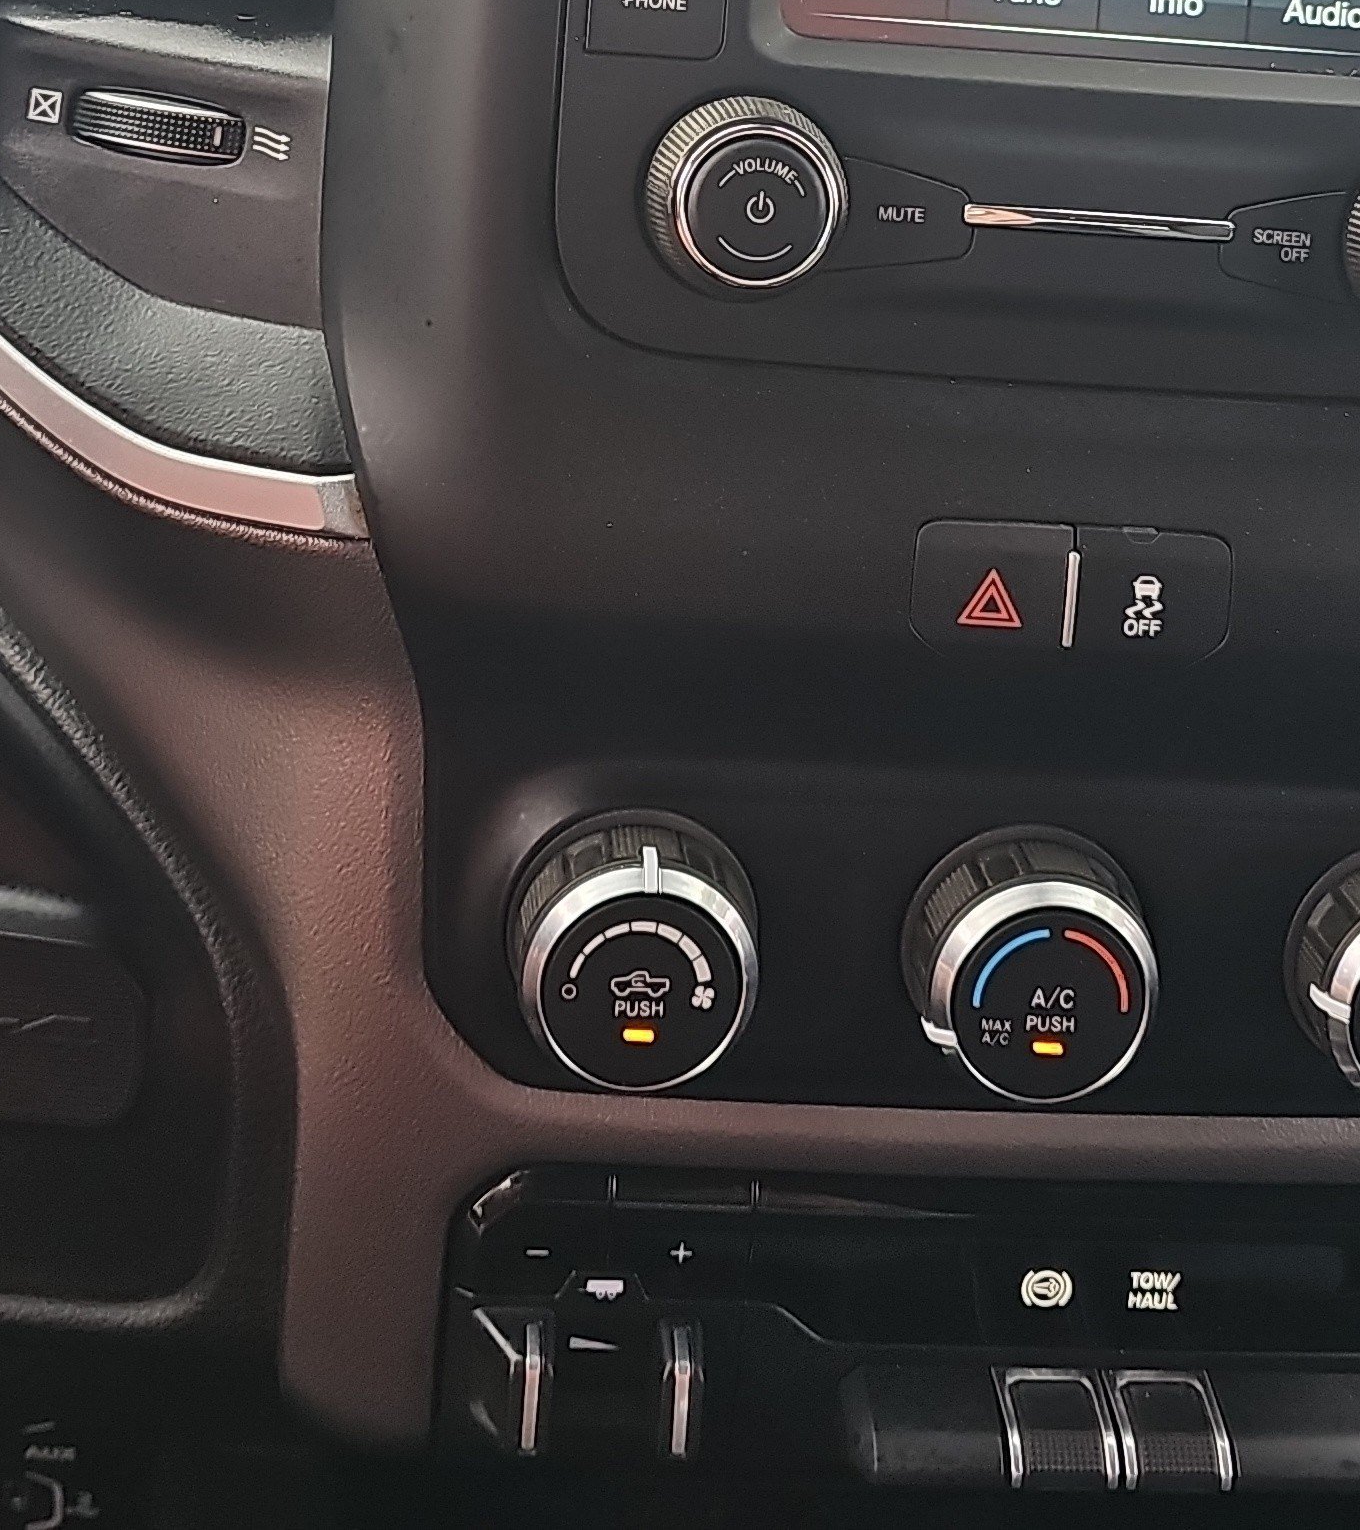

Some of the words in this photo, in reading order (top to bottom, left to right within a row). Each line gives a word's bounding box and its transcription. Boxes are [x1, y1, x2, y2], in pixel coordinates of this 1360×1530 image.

[733, 158, 798, 184] VOLUME
[878, 206, 926, 223] MUTE
[1253, 228, 1311, 247] SCREEN
[1280, 248, 1310, 263] OFF
[1123, 619, 1163, 637] OFF
[1031, 986, 1075, 1009] A/C
[614, 1000, 665, 1019] PUSH
[981, 1017, 1012, 1032] MAX
[1025, 1015, 1075, 1032] PUSH
[981, 1032, 1010, 1046] A/C
[1127, 1291, 1179, 1310] HAUL
